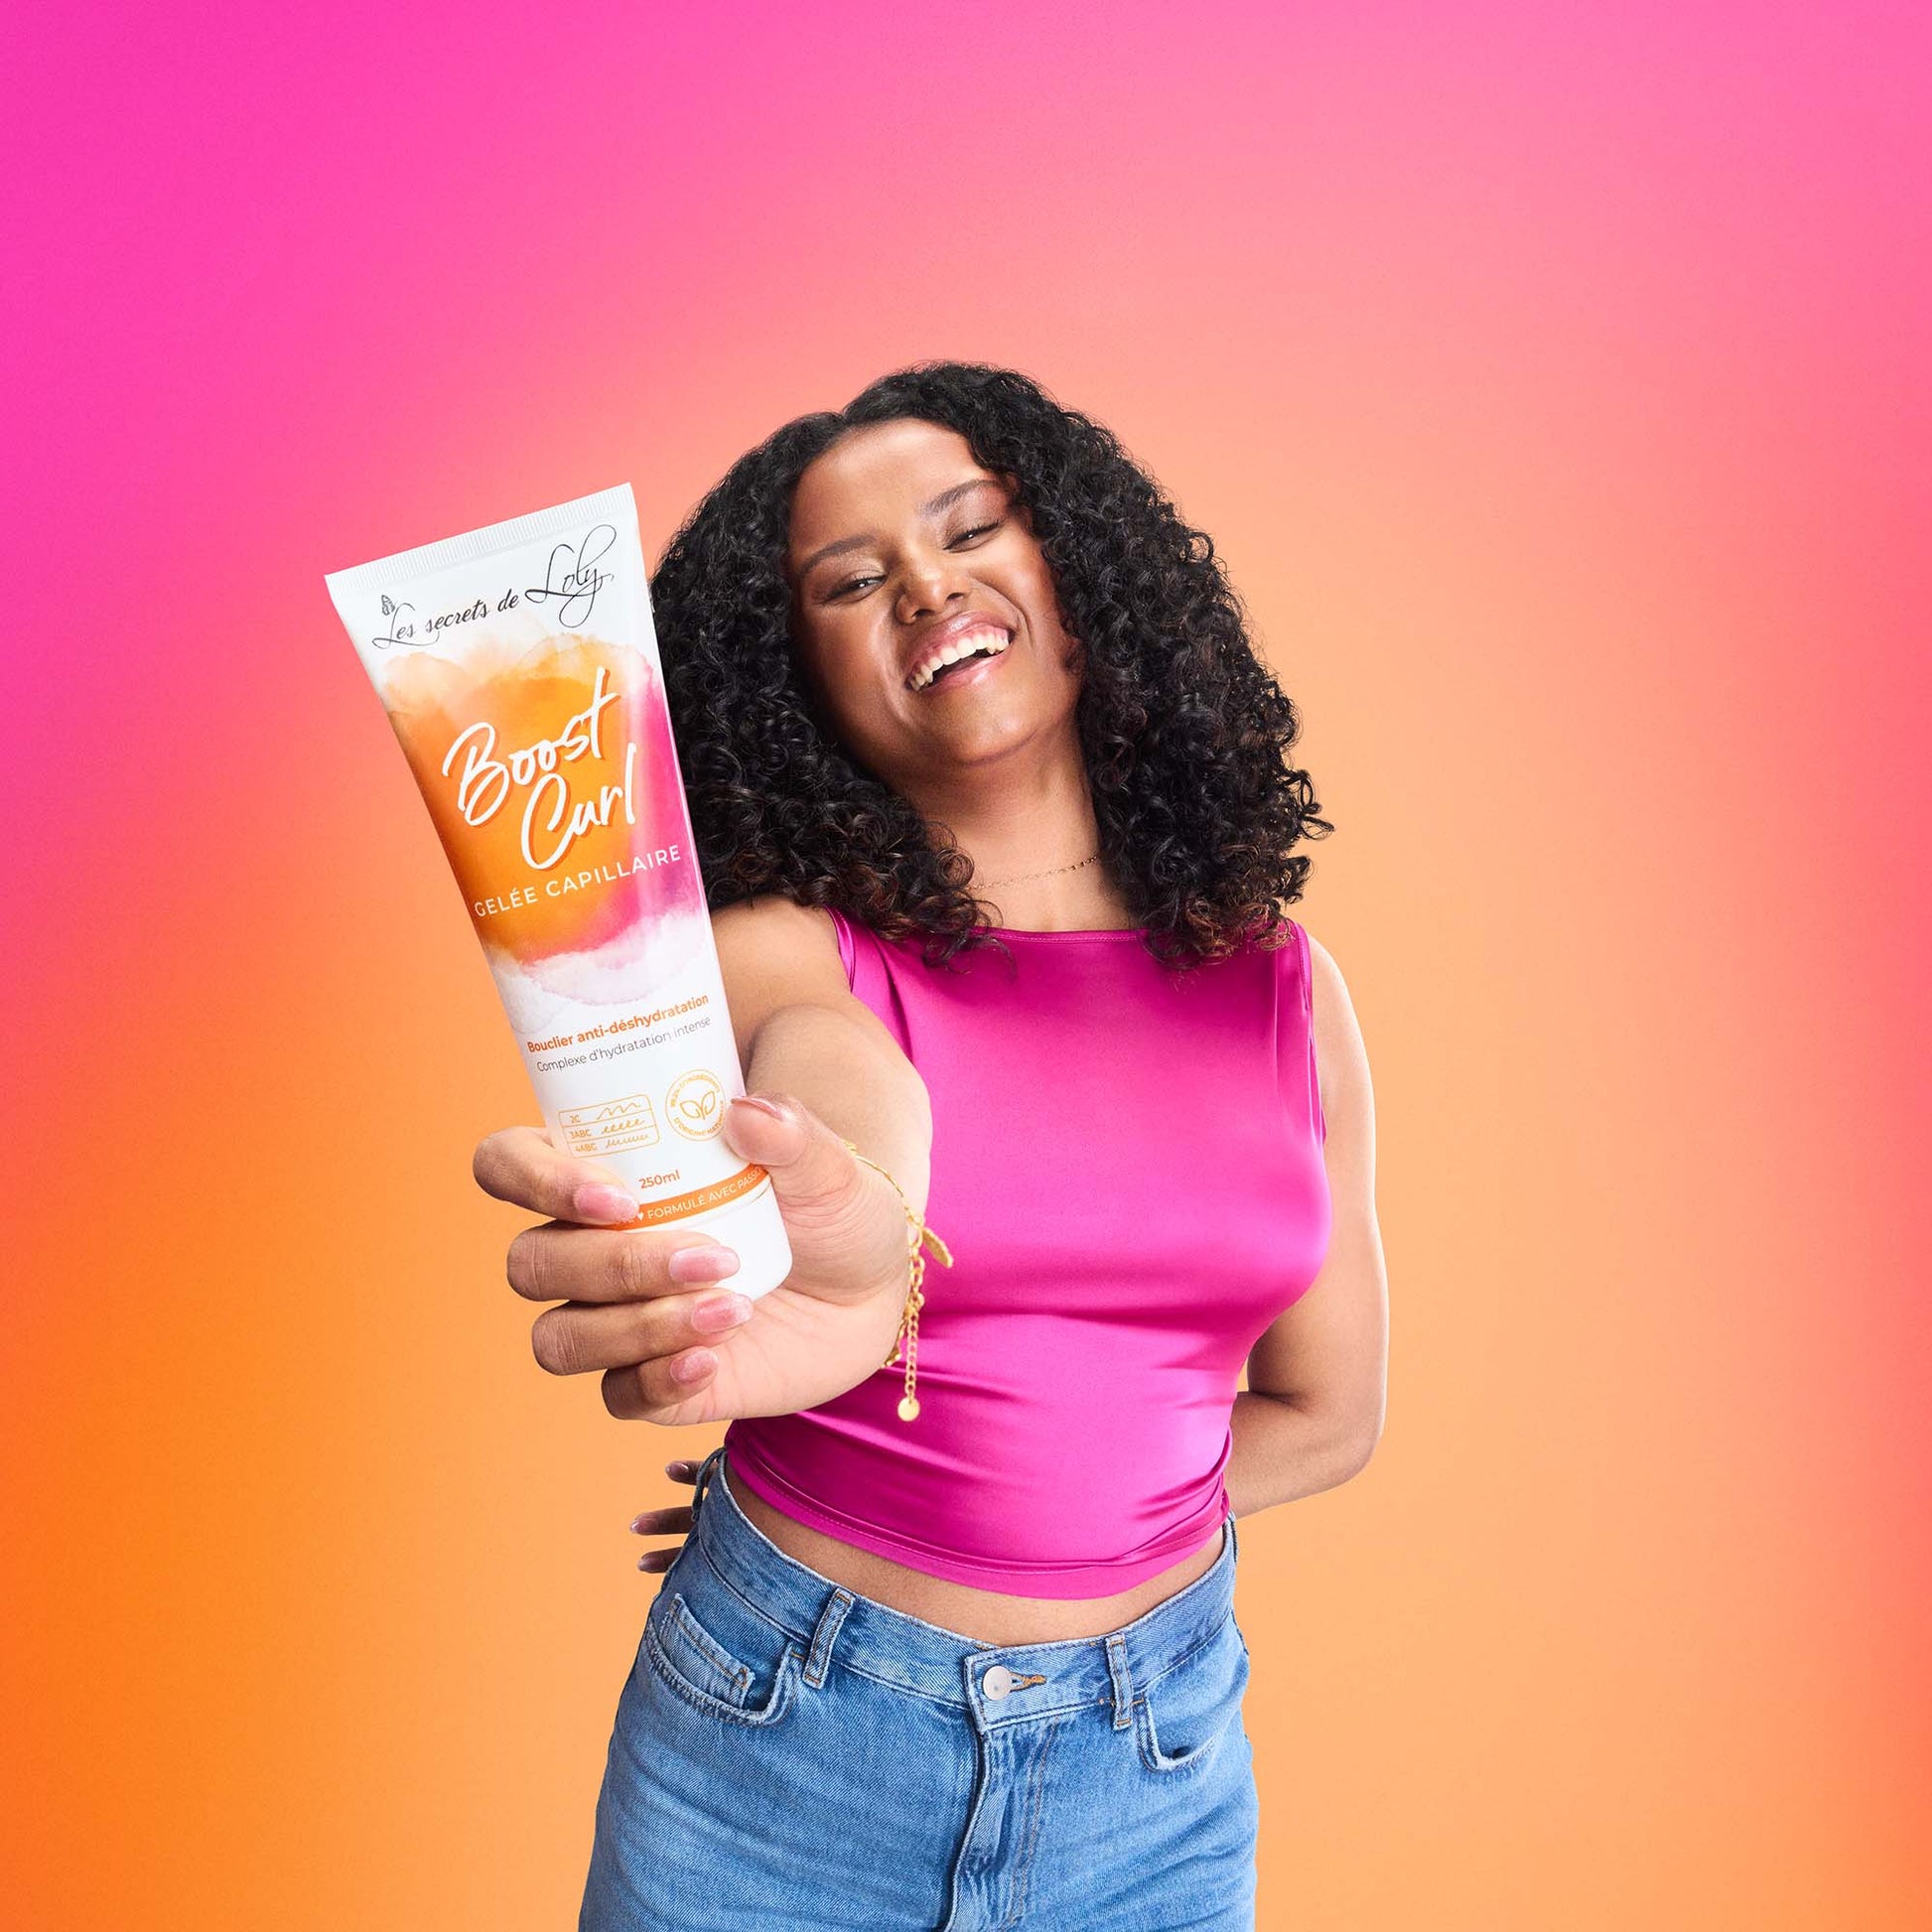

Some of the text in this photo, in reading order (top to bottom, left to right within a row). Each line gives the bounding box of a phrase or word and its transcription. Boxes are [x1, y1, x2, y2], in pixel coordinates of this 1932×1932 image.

[371, 523, 616, 649] Les secrets de Loly
[442, 666, 621, 827] Boost
[520, 742, 637, 870] Curl
[474, 845, 681, 917] GELÉE CAPILLAIRE
[527, 994, 710, 1053] Bouclier anti-déshydratation
[536, 1016, 712, 1072] Complexe d'hydratation intense
[638, 1170, 681, 1189] 250ml
[647, 1195, 705, 1220] FORMULÉ
[708, 1183, 738, 1203] AVEC
